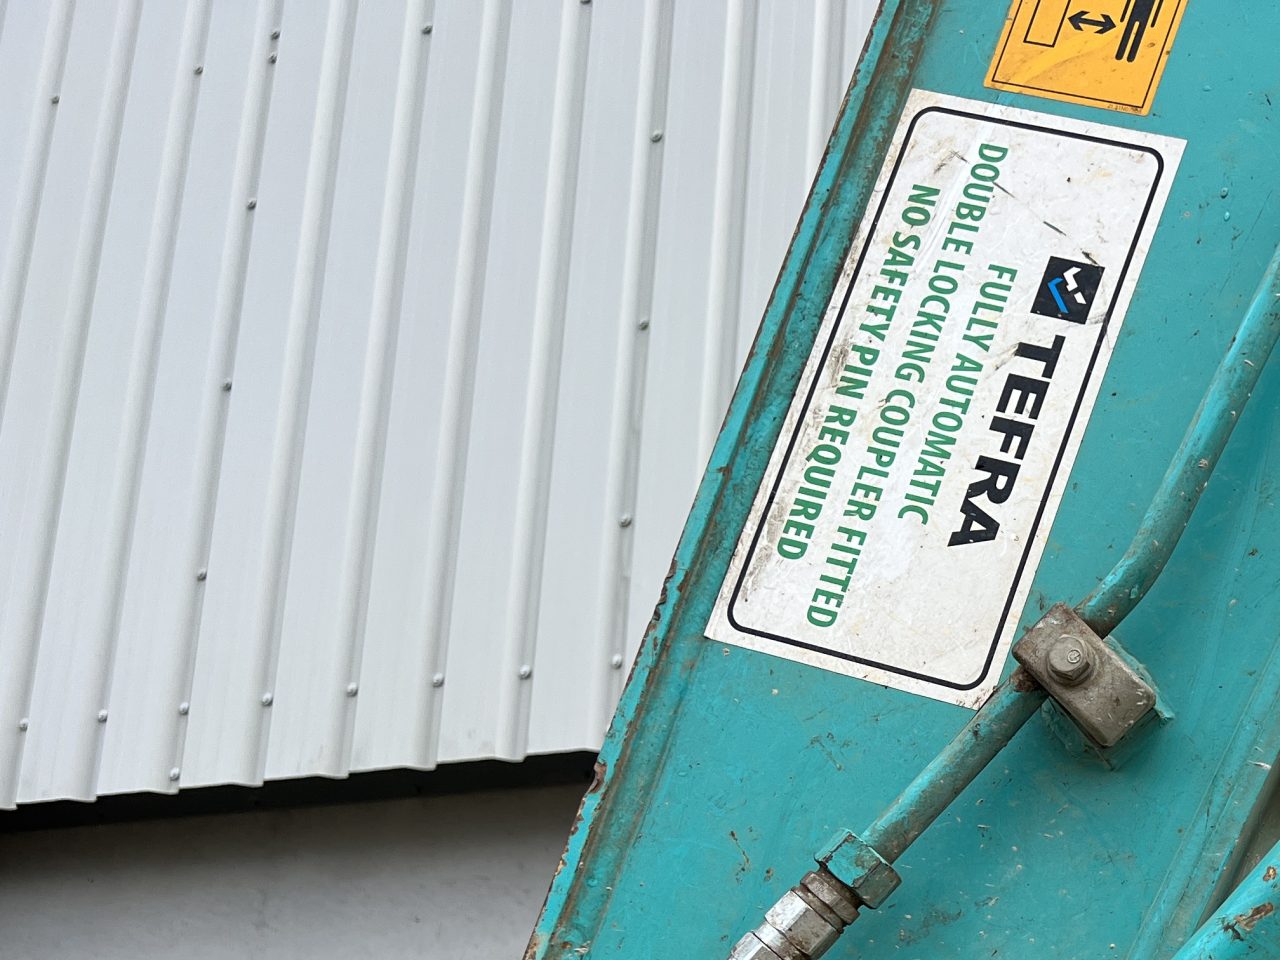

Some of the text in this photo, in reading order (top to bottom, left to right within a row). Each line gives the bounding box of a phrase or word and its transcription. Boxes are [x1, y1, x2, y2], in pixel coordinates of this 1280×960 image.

[777, 184, 940, 561] NO SAFETY PIN REQUIRED
[807, 143, 1008, 628] DOUBLE LOCKING COUPLER FITTED
[898, 264, 1017, 526] FULLY AUTOMATIC
[947, 334, 1066, 547] TEFRA
